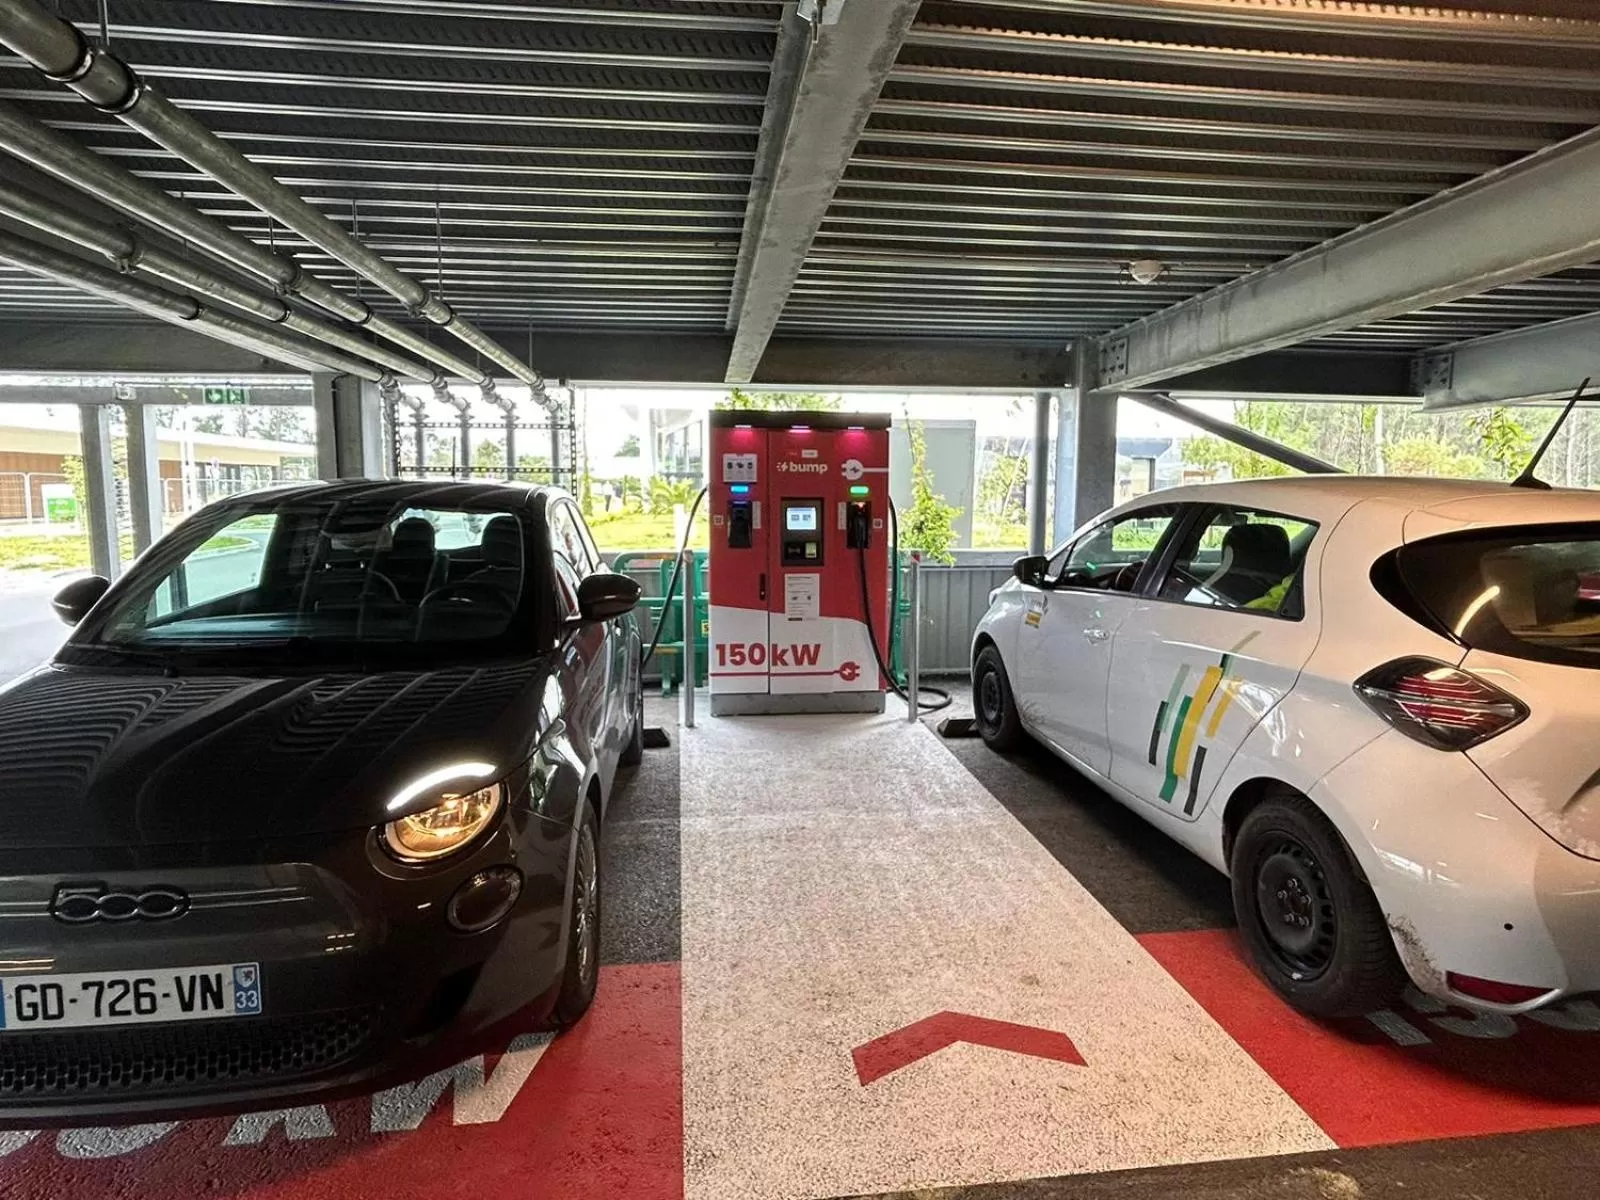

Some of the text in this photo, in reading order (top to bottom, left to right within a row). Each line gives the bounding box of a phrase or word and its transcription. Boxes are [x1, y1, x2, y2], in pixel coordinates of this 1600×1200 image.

[789, 462, 828, 475] bump
[715, 643, 821, 667] 150kW
[51, 881, 190, 924] 500
[14, 973, 225, 1022] GD-726-VN
[236, 990, 258, 1009] 33
